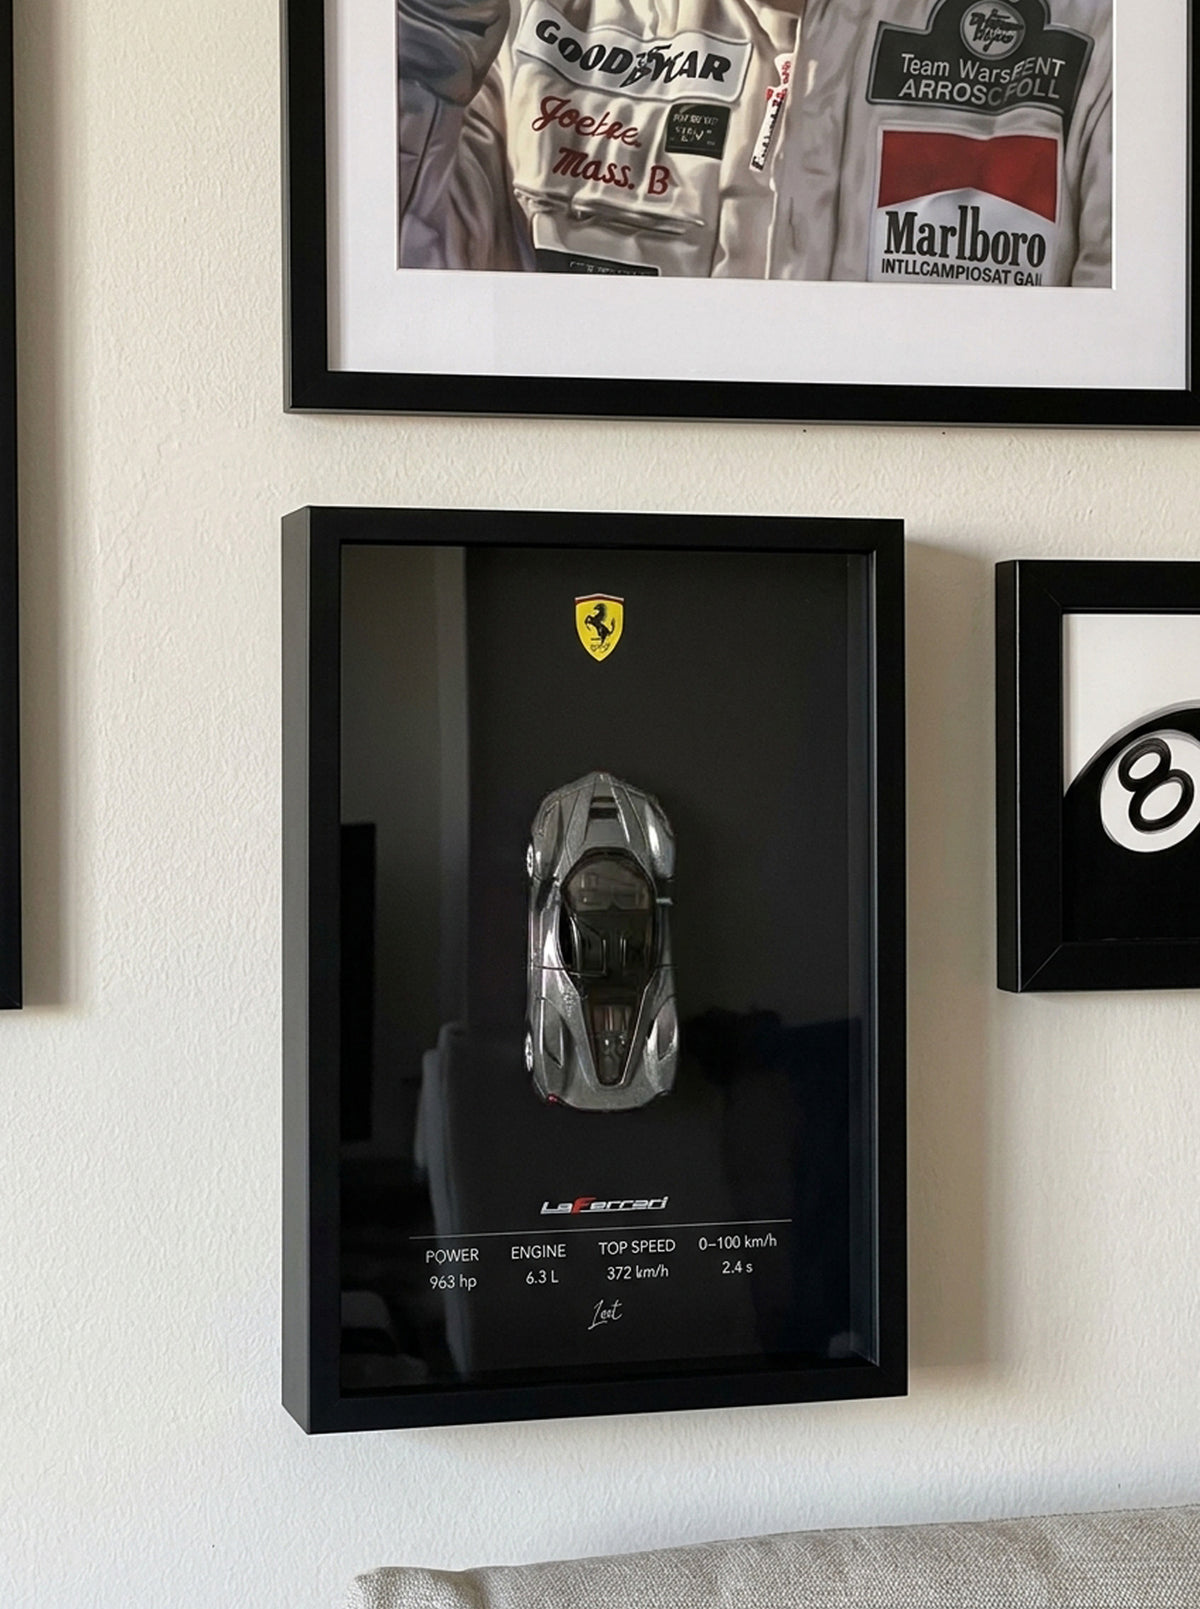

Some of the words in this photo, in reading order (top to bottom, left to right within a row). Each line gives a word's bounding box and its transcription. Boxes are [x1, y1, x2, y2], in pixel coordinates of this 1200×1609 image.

[901, 52, 950, 77] Team
[552, 147, 635, 190] Mass.
[647, 164, 671, 195] B
[883, 204, 1047, 268] Marlboro
[1117, 737, 1195, 835] 8
[540, 1195, 669, 1215] LaFerrari
[598, 1240, 628, 1256] TOP
[631, 1238, 676, 1254] SPEED
[744, 1232, 777, 1249] km/h
[425, 1247, 480, 1265] POWER
[511, 1243, 567, 1260] ENGINE
[607, 1265, 632, 1281] 372
[635, 1263, 669, 1279] km/h
[722, 1260, 743, 1274] 2.4
[745, 1263, 753, 1273] s
[429, 1274, 456, 1290] 963
[459, 1273, 478, 1292] hp
[525, 1269, 547, 1285] 6.3
[550, 1269, 559, 1284] L
